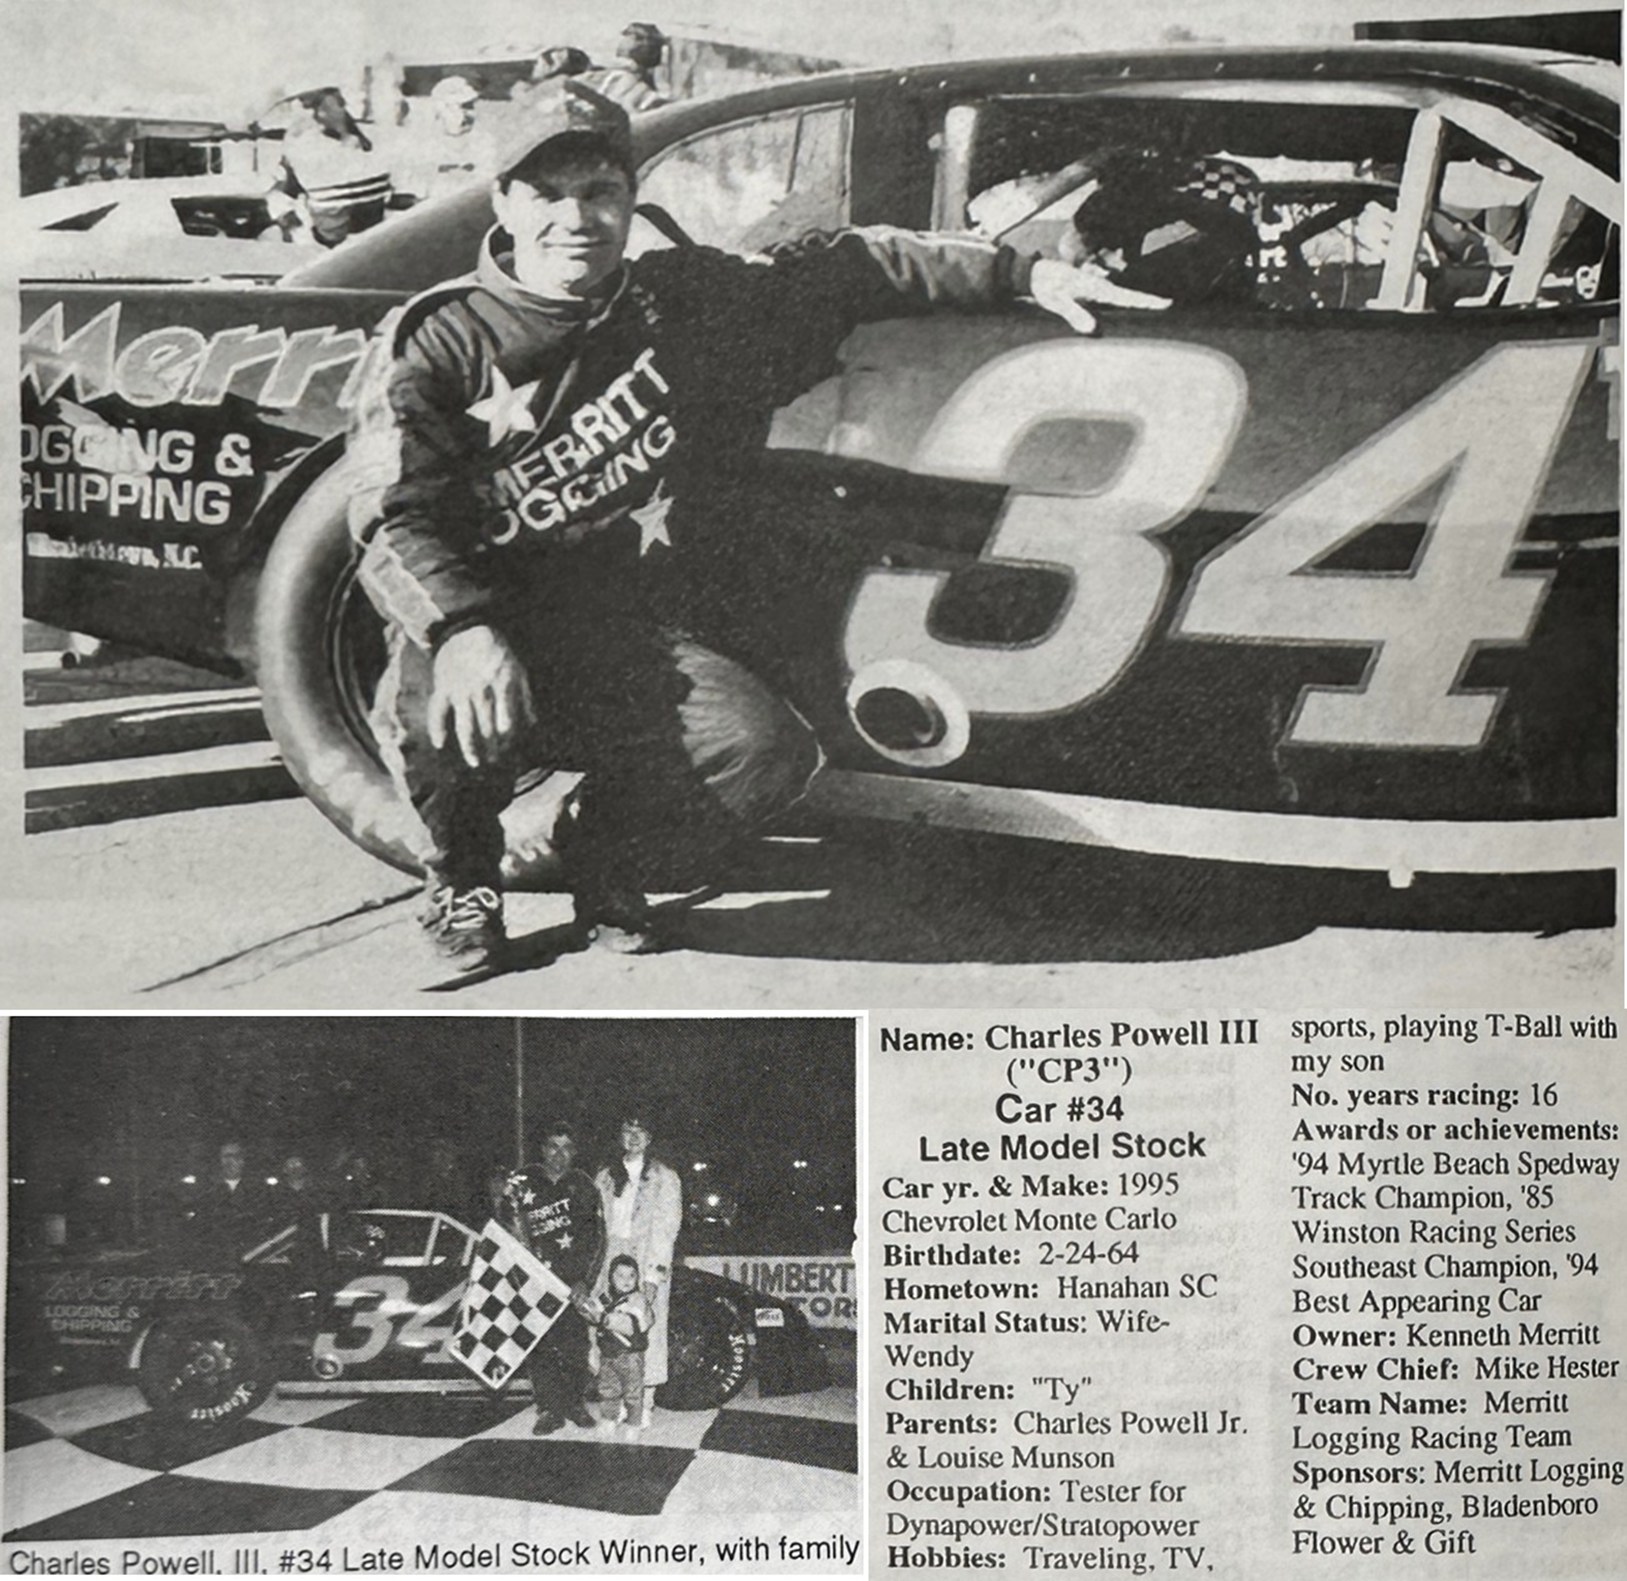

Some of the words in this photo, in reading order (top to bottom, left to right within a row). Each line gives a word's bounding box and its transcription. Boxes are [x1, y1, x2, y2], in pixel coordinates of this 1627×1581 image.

[215, 433, 253, 477] &
[843, 337, 1598, 752] 34
[880, 1027, 974, 1053] Name:
[984, 1023, 1102, 1051] Charles
[1110, 1020, 1209, 1047] Powell
[1219, 1018, 1259, 1045] III
[1291, 1017, 1376, 1045] sports,
[1383, 1013, 1479, 1044] playing
[1484, 1013, 1563, 1038] T-Ball
[1569, 1014, 1618, 1039] with
[1006, 1056, 1133, 1090] ("CP3")
[1291, 1054, 1332, 1079] my
[1340, 1054, 1385, 1073] son
[995, 1092, 1058, 1125] Car
[1066, 1094, 1125, 1123] #34
[1291, 1082, 1339, 1107] No.
[1346, 1088, 1419, 1113] years
[1427, 1082, 1519, 1113] racing:
[1531, 1081, 1558, 1107] 16
[1291, 1117, 1399, 1142] Awards
[1406, 1123, 1437, 1141] or
[1444, 1116, 1619, 1141] achievements:
[919, 1135, 991, 1163] Late
[1000, 1132, 1100, 1161] Model
[1111, 1130, 1207, 1160] Stock
[1292, 1151, 1329, 1177] '94
[1337, 1151, 1425, 1182] Myrtle
[1432, 1151, 1510, 1176] Beach
[1517, 1150, 1620, 1182] Spedway
[881, 1176, 935, 1200] Car
[942, 1181, 980, 1205] yr.
[988, 1174, 1013, 1198] &
[1021, 1173, 1109, 1198] Make:
[1119, 1171, 1180, 1197] 1995
[1290, 1185, 1367, 1210] Track
[1374, 1184, 1512, 1216] Champion,
[1520, 1184, 1554, 1210] '85
[881, 1209, 1008, 1234] Chevrolet
[1014, 1208, 1098, 1232] Monte
[1105, 1206, 1178, 1231] Carlo
[1291, 1219, 1400, 1245] Winston
[1409, 1219, 1498, 1250] Racing
[1504, 1218, 1577, 1244] Series
[883, 1242, 1021, 1267] Birthdate:
[1038, 1240, 1140, 1266] 2-24-64
[1292, 1253, 1418, 1280] Southeast
[1424, 1253, 1558, 1284] Champion,
[1566, 1252, 1599, 1277] '94
[883, 1277, 1039, 1301] Hometown:
[1057, 1275, 1170, 1300] Hanahan
[1179, 1272, 1218, 1299] SC
[45, 1305, 120, 1319] LOGGING
[126, 1306, 140, 1319] &
[1292, 1289, 1351, 1314] Best
[1358, 1288, 1492, 1320] Appearing
[1498, 1287, 1543, 1313] Car
[51, 1319, 133, 1333] CHIPPING
[883, 1310, 987, 1335] Marital
[994, 1310, 1087, 1334] Status:
[1095, 1308, 1171, 1333] Wife-
[1292, 1323, 1396, 1348] Owner:
[1406, 1322, 1511, 1348] Kenneth
[1518, 1322, 1601, 1346] Merritt
[884, 1344, 975, 1374] Wendy
[1292, 1357, 1368, 1381] Crew
[1376, 1357, 1459, 1381] Chief:
[1475, 1356, 1540, 1380] Mike
[1547, 1355, 1620, 1380] Hester
[885, 1377, 1015, 1401] Children:
[1032, 1376, 1092, 1407] "Ty"
[1291, 1391, 1371, 1415] Team
[1378, 1391, 1467, 1416] Name:
[1483, 1389, 1569, 1415] Merritt
[885, 1411, 997, 1435] Parents:
[1013, 1410, 1112, 1436] Charles
[1120, 1410, 1209, 1435] Powell
[1216, 1409, 1248, 1435] Jr.
[1292, 1425, 1401, 1456] Logging
[1410, 1425, 1498, 1456] Racing
[1504, 1424, 1573, 1449] Team
[886, 1444, 909, 1469] &
[917, 1445, 1004, 1469] Louise
[1011, 1445, 1115, 1469] Munson
[1292, 1460, 1426, 1491] Sponsors:
[1434, 1459, 1523, 1484] Merritt
[1530, 1456, 1625, 1488] Logging
[886, 1479, 1051, 1509] Occupation:
[1059, 1479, 1142, 1503] Tester
[1149, 1479, 1187, 1503] for
[1293, 1493, 1317, 1519] &
[1325, 1494, 1453, 1526] Chipping,
[1461, 1493, 1599, 1519] Bladenboro
[886, 1512, 1201, 1543] Dynapower/Stratopower
[1292, 1529, 1385, 1555] Flower
[1392, 1529, 1416, 1555] &
[1424, 1528, 1477, 1556] Gift
[8, 1550, 111, 1576] Charles
[278, 1548, 333, 1574] #34
[343, 1546, 404, 1573] Late
[414, 1542, 501, 1570] Model
[511, 1540, 591, 1568] Stock
[598, 1538, 705, 1567] Winner,
[715, 1535, 770, 1562] with
[777, 1533, 861, 1566] family
[887, 1545, 1006, 1569] Hobbies:
[1022, 1545, 1156, 1576] Traveling,
[1162, 1546, 1214, 1572] TV,
